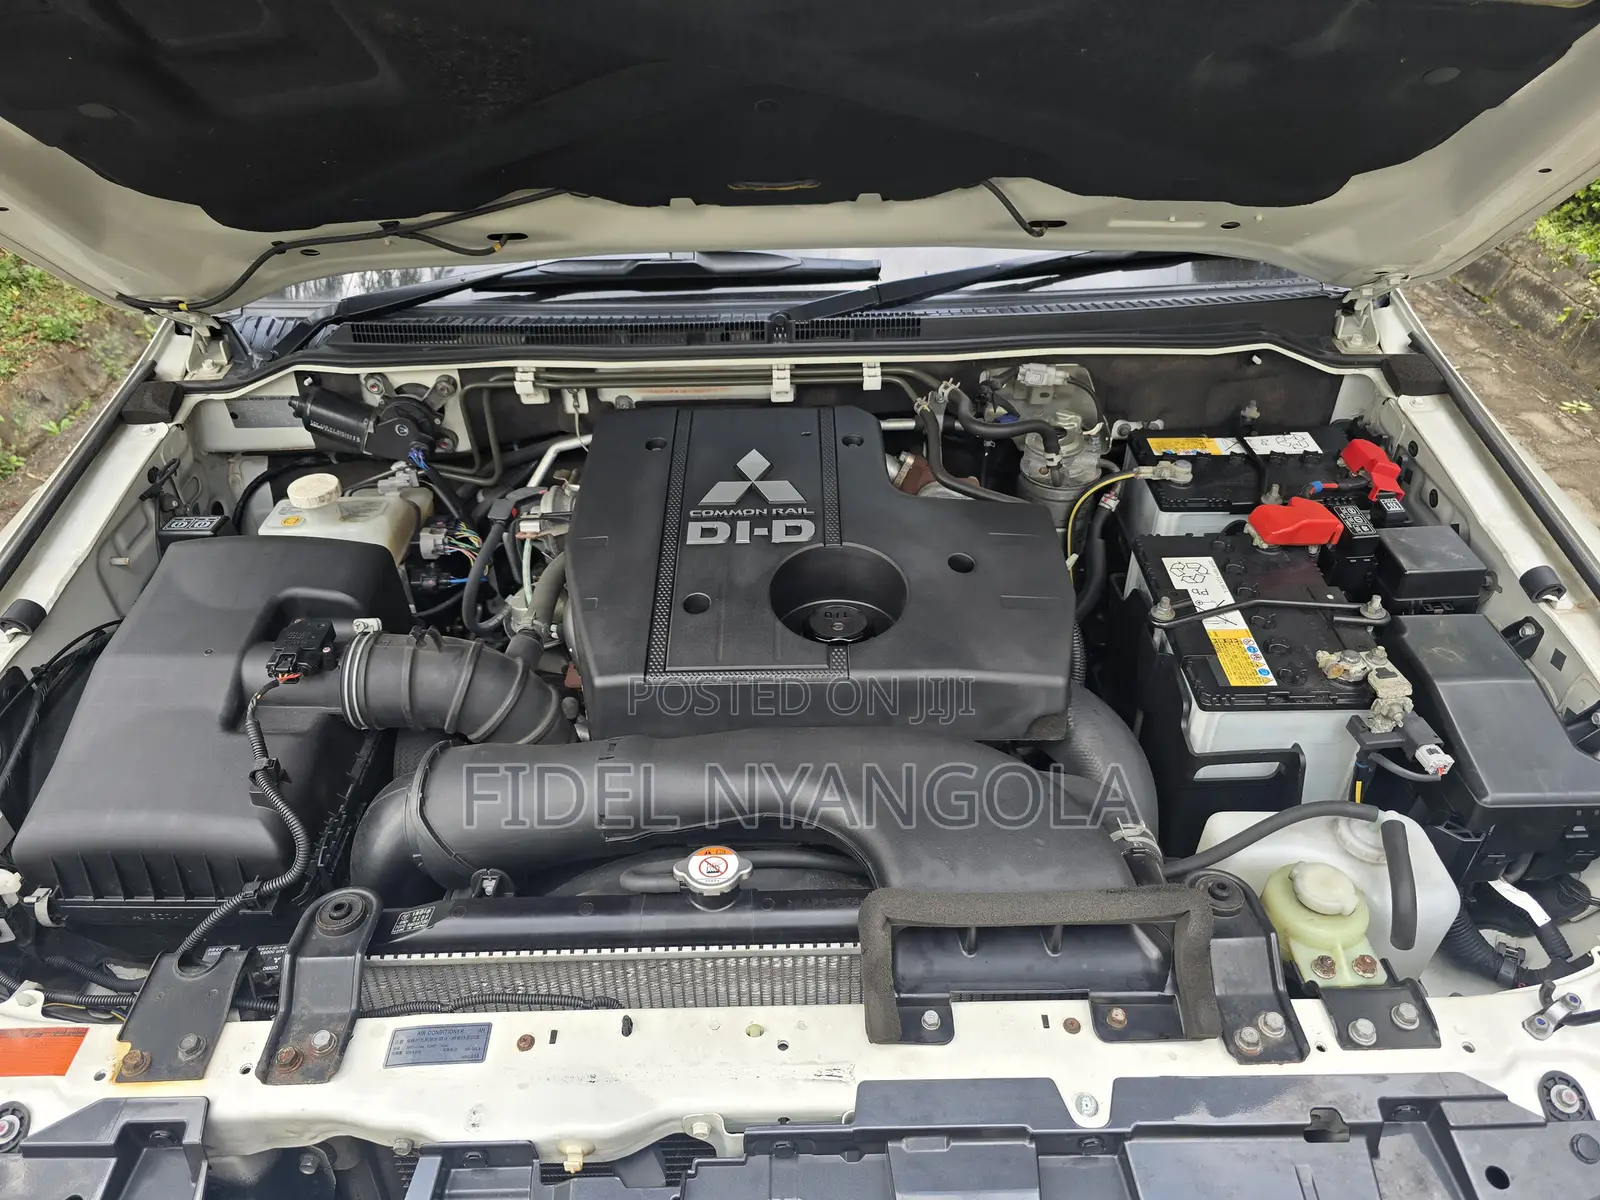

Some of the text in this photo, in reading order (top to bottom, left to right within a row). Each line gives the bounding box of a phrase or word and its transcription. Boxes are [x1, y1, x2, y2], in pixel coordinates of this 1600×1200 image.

[689, 507, 815, 518] COMMON RAIL
[686, 519, 816, 545] DI-D
[824, 610, 851, 620] OIL
[428, 1028, 465, 1036] CONDITIONER
